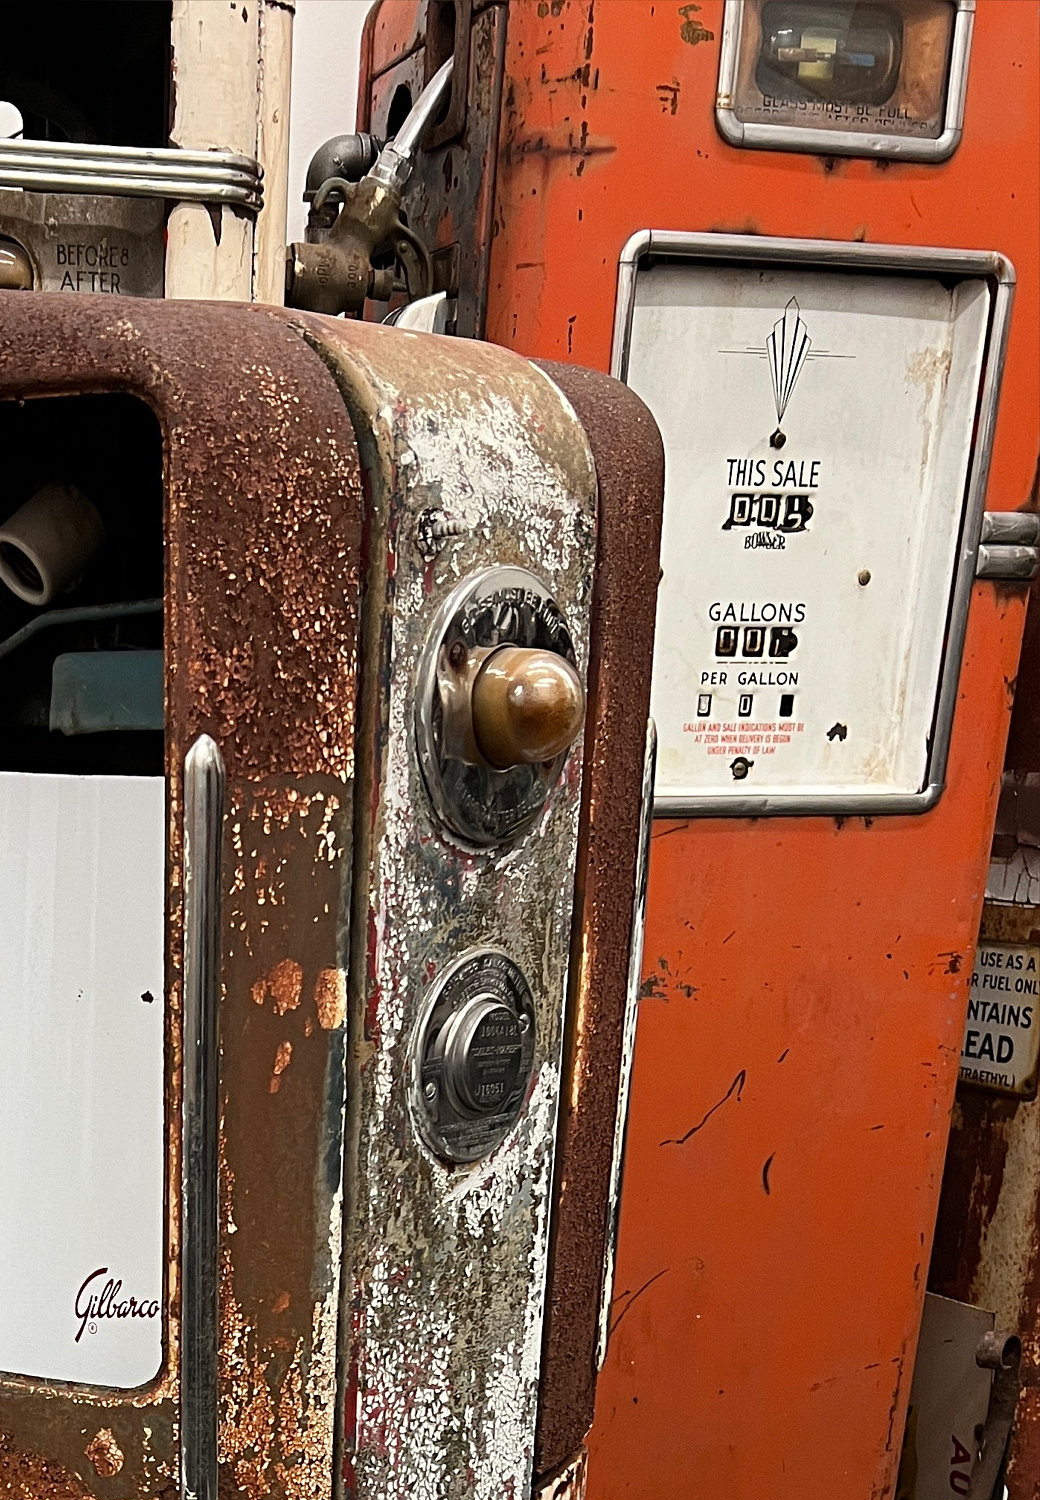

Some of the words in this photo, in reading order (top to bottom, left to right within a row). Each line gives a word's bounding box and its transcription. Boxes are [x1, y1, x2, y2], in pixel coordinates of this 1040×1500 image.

[60, 269, 121, 294] AFTER
[726, 458, 767, 487] THIS
[771, 460, 821, 488] SALE
[709, 602, 806, 623] GALLONS
[701, 671, 728, 685] PER
[737, 671, 799, 686] GALLON
[980, 951, 1003, 969] USE
[1005, 954, 1024, 971] AS
[1026, 957, 1037, 973] A
[982, 973, 1012, 992] FUEL
[1015, 977, 1040, 996] ONL
[966, 999, 1034, 1030] NTAINS
[960, 1029, 1014, 1064] EAD
[960, 1066, 1016, 1088] TRAETHYL)
[74, 1266, 160, 1344] Gilbarco
